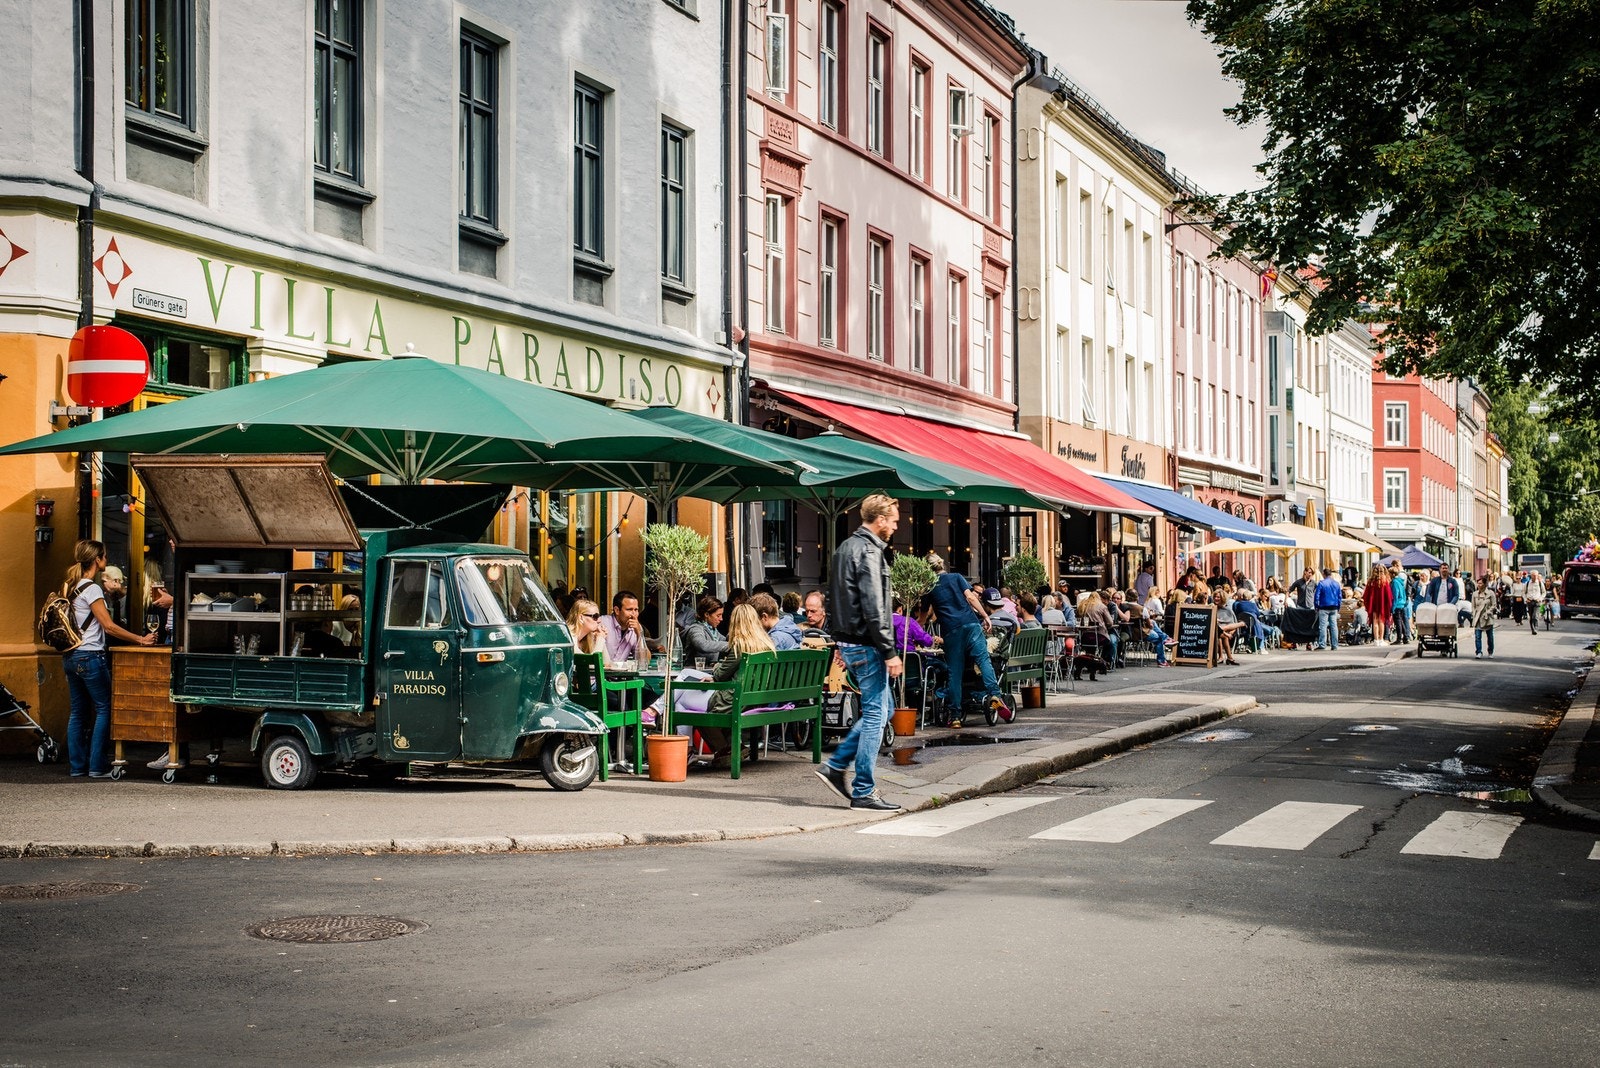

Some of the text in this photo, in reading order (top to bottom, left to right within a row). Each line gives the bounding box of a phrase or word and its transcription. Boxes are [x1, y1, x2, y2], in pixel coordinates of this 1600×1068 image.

[137, 293, 183, 313] Grüners gate
[197, 257, 682, 408] VILLA PARADISO
[404, 670, 435, 681] VILLA
